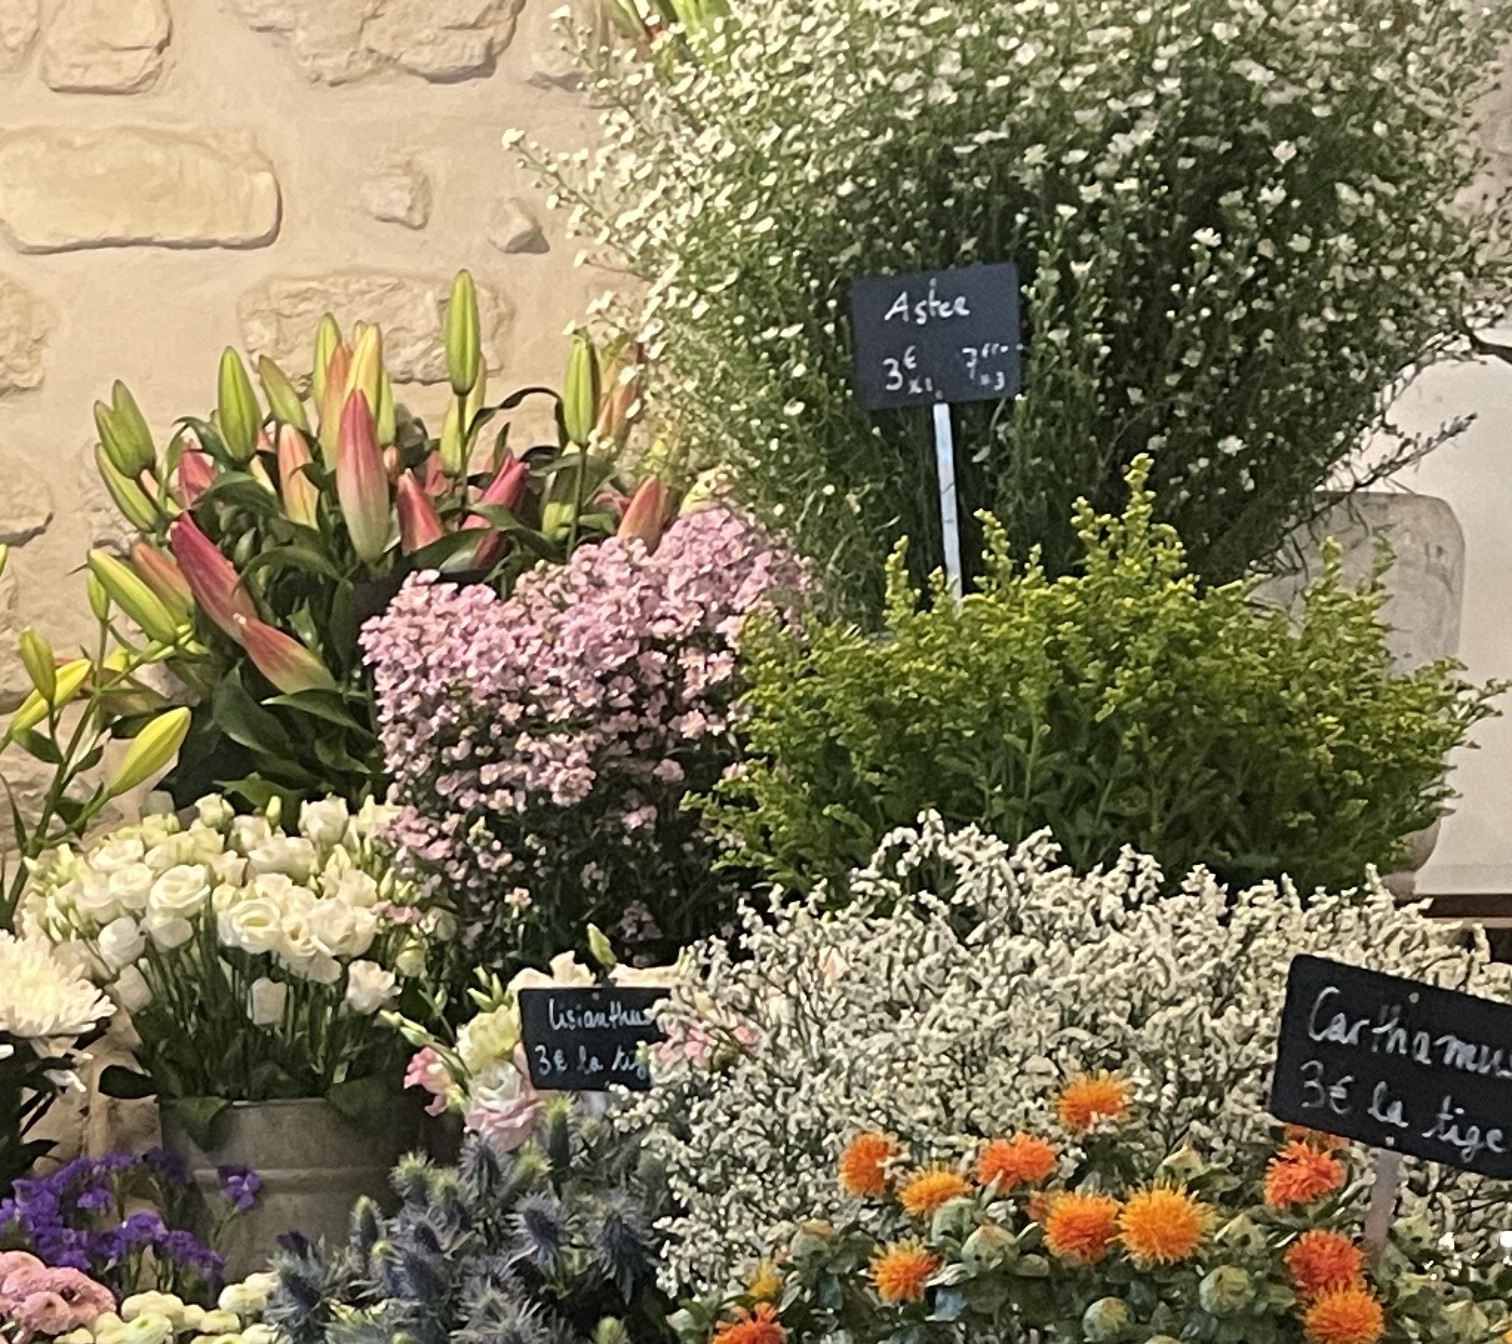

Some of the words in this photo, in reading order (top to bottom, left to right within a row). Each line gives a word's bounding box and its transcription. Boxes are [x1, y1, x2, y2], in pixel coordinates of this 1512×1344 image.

[549, 998, 653, 1031] Lisianthu
[1308, 986, 1512, 1080] Carthamu
[534, 1045, 567, 1076] 3€
[576, 1046, 604, 1075] la
[611, 1045, 647, 1080] tig
[1300, 1060, 1355, 1114] 3€
[1367, 1081, 1409, 1128] la
[1421, 1095, 1506, 1163] tige
